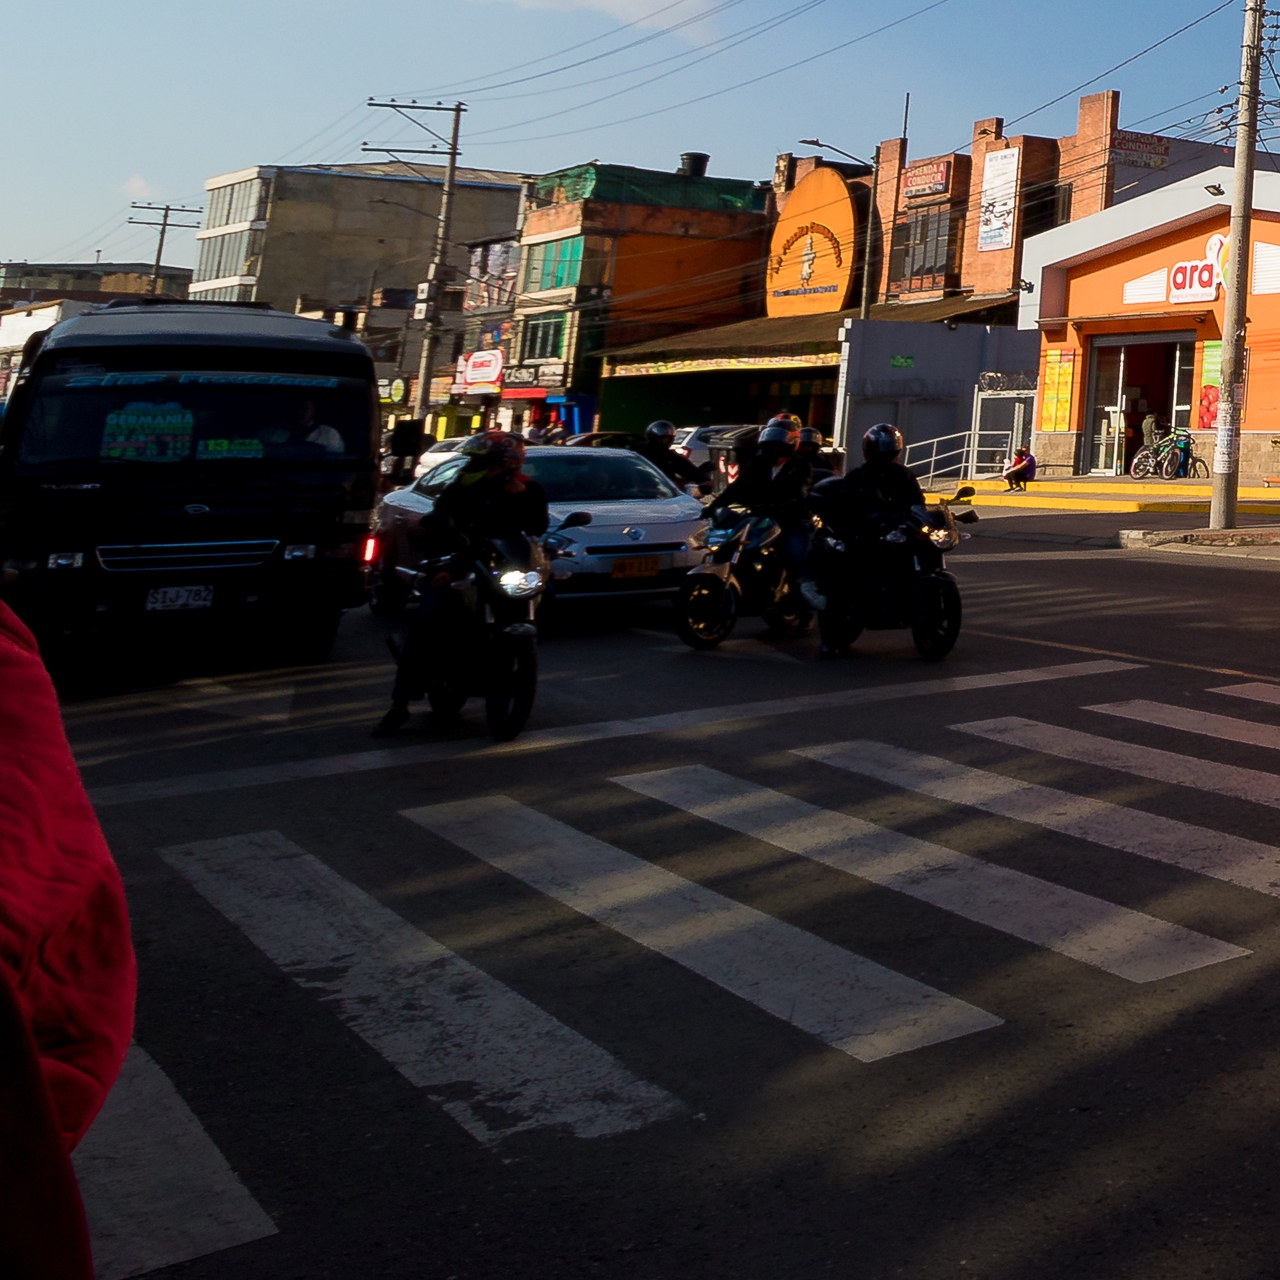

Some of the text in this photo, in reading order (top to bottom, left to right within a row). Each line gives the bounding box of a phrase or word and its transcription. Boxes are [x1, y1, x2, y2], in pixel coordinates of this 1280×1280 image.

[1112, 131, 1169, 146] APRENDA A
[1114, 140, 1165, 154] CONDUCIR
[906, 164, 937, 177] APRENDA
[907, 172, 942, 186] CONDUCIR
[1173, 264, 1213, 290] ara
[106, 413, 194, 425] GERMANIA
